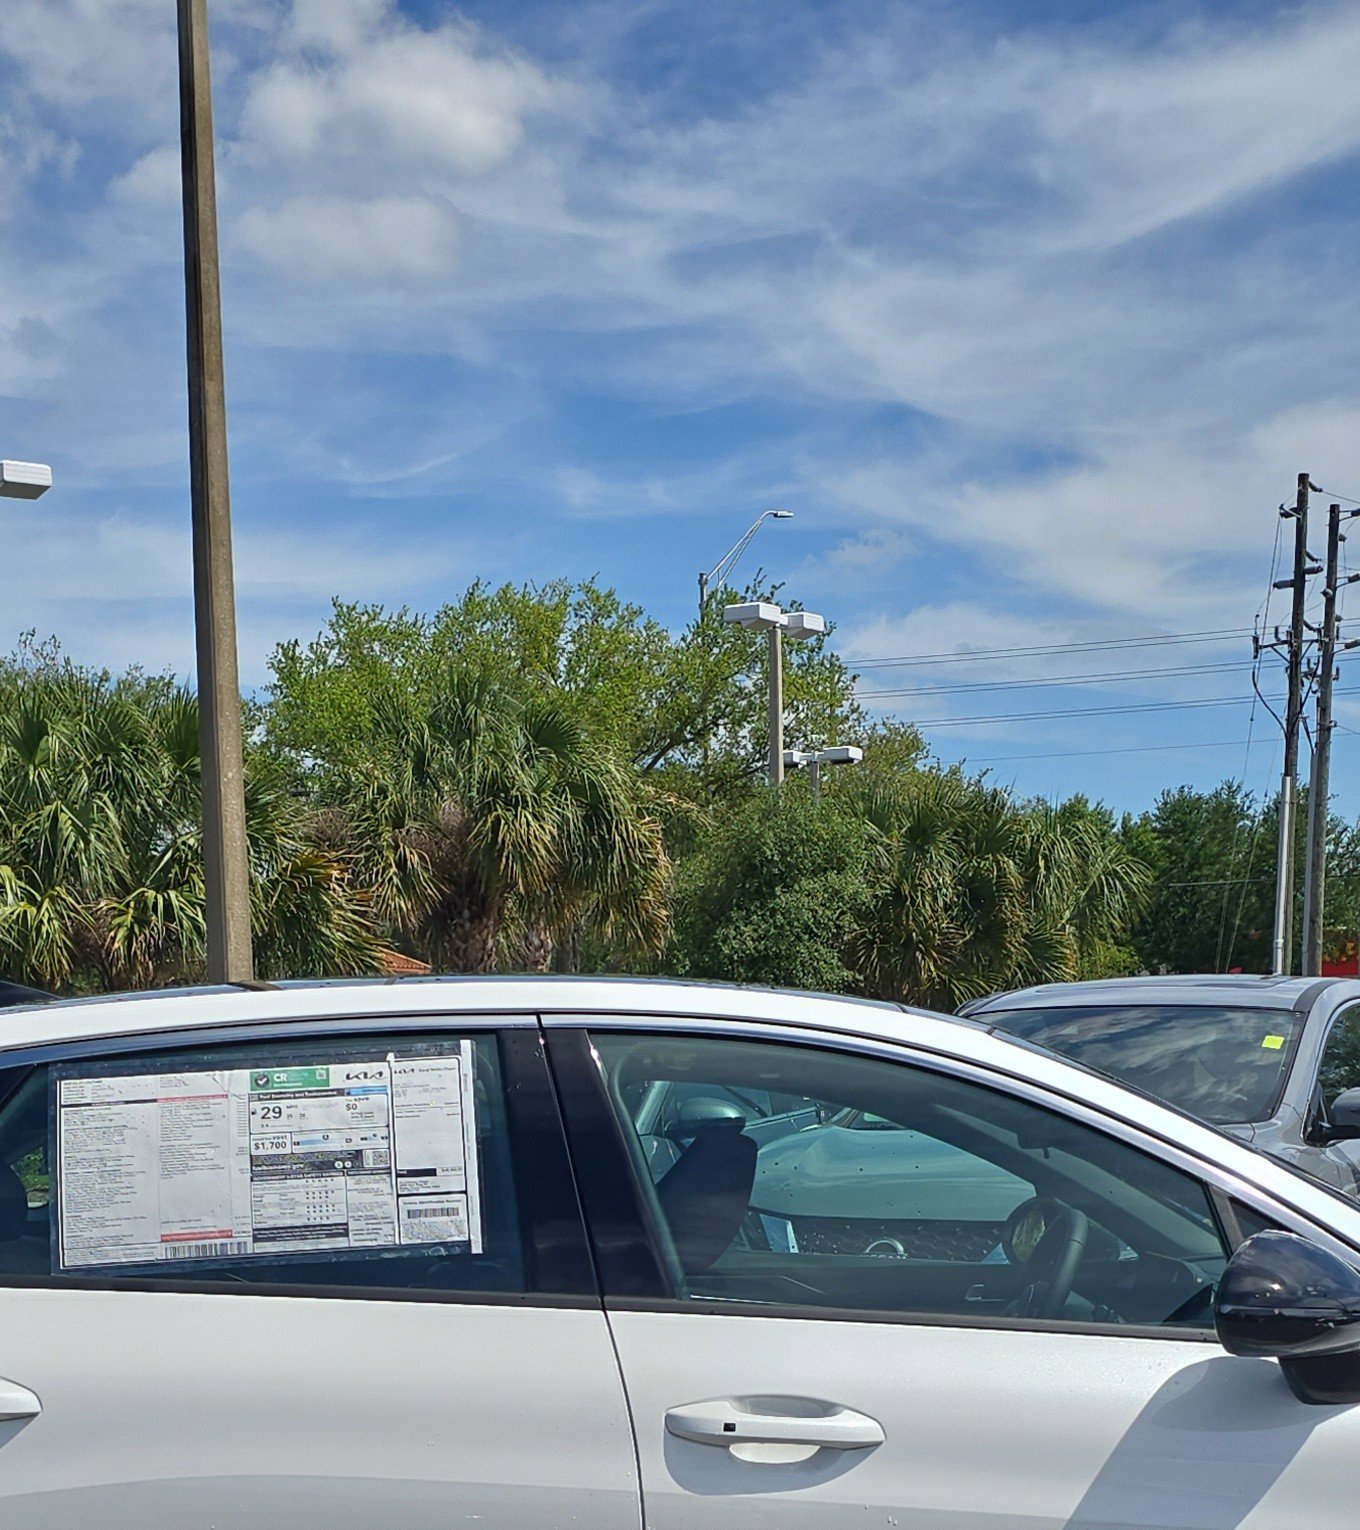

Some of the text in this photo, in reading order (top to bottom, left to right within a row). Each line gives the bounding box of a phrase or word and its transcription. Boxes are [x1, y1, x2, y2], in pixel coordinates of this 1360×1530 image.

[345, 1103, 358, 1111] $0
[260, 1105, 282, 1120] 29
[254, 1141, 287, 1151] $1,700
